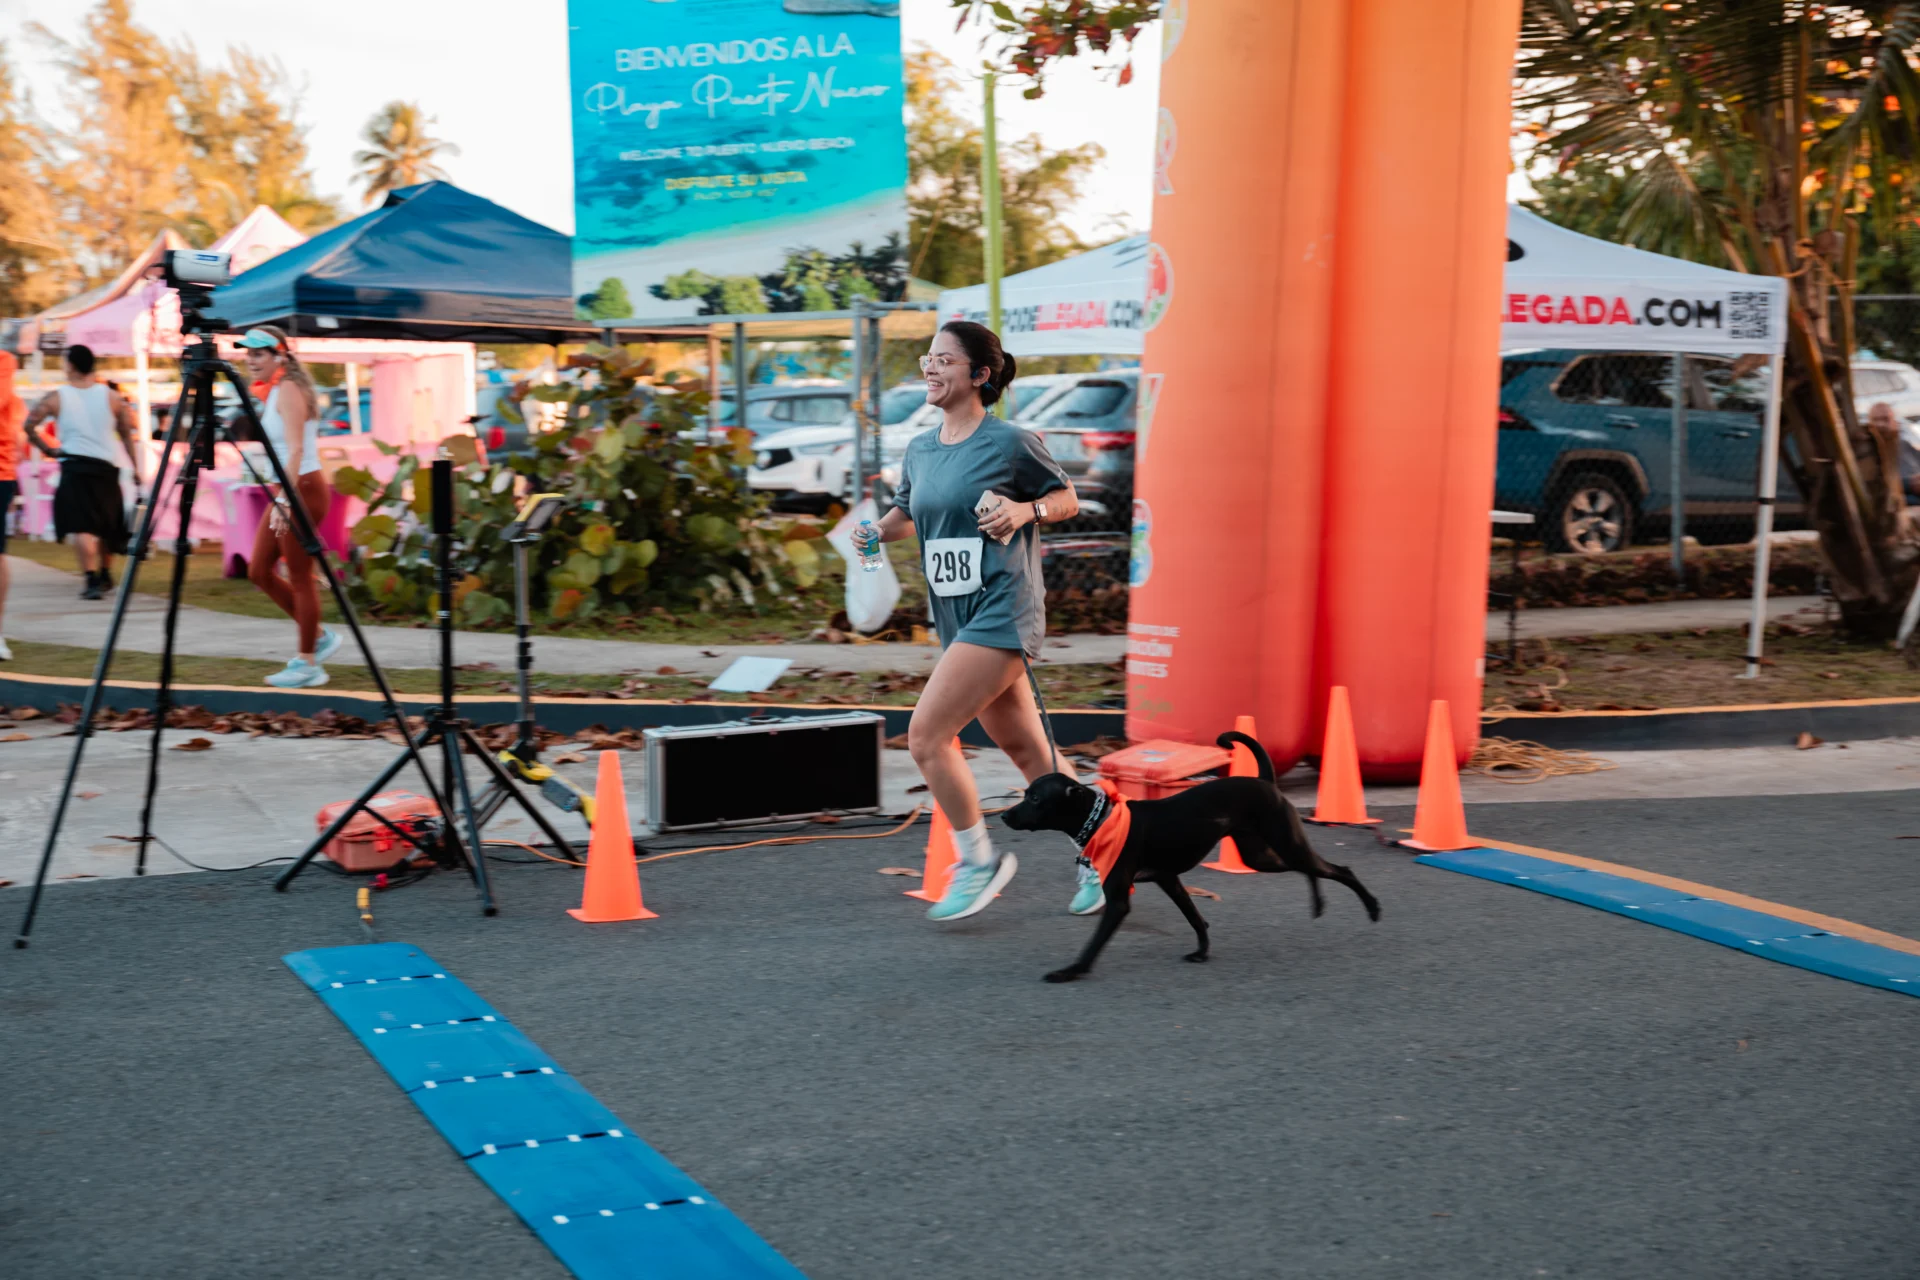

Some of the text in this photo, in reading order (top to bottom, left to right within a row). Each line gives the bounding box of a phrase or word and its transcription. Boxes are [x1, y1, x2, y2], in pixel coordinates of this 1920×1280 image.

[615, 32, 856, 72] BIENVENIDOS A LA
[1500, 293, 1721, 328] EGADA.COM
[932, 550, 971, 583] 298
